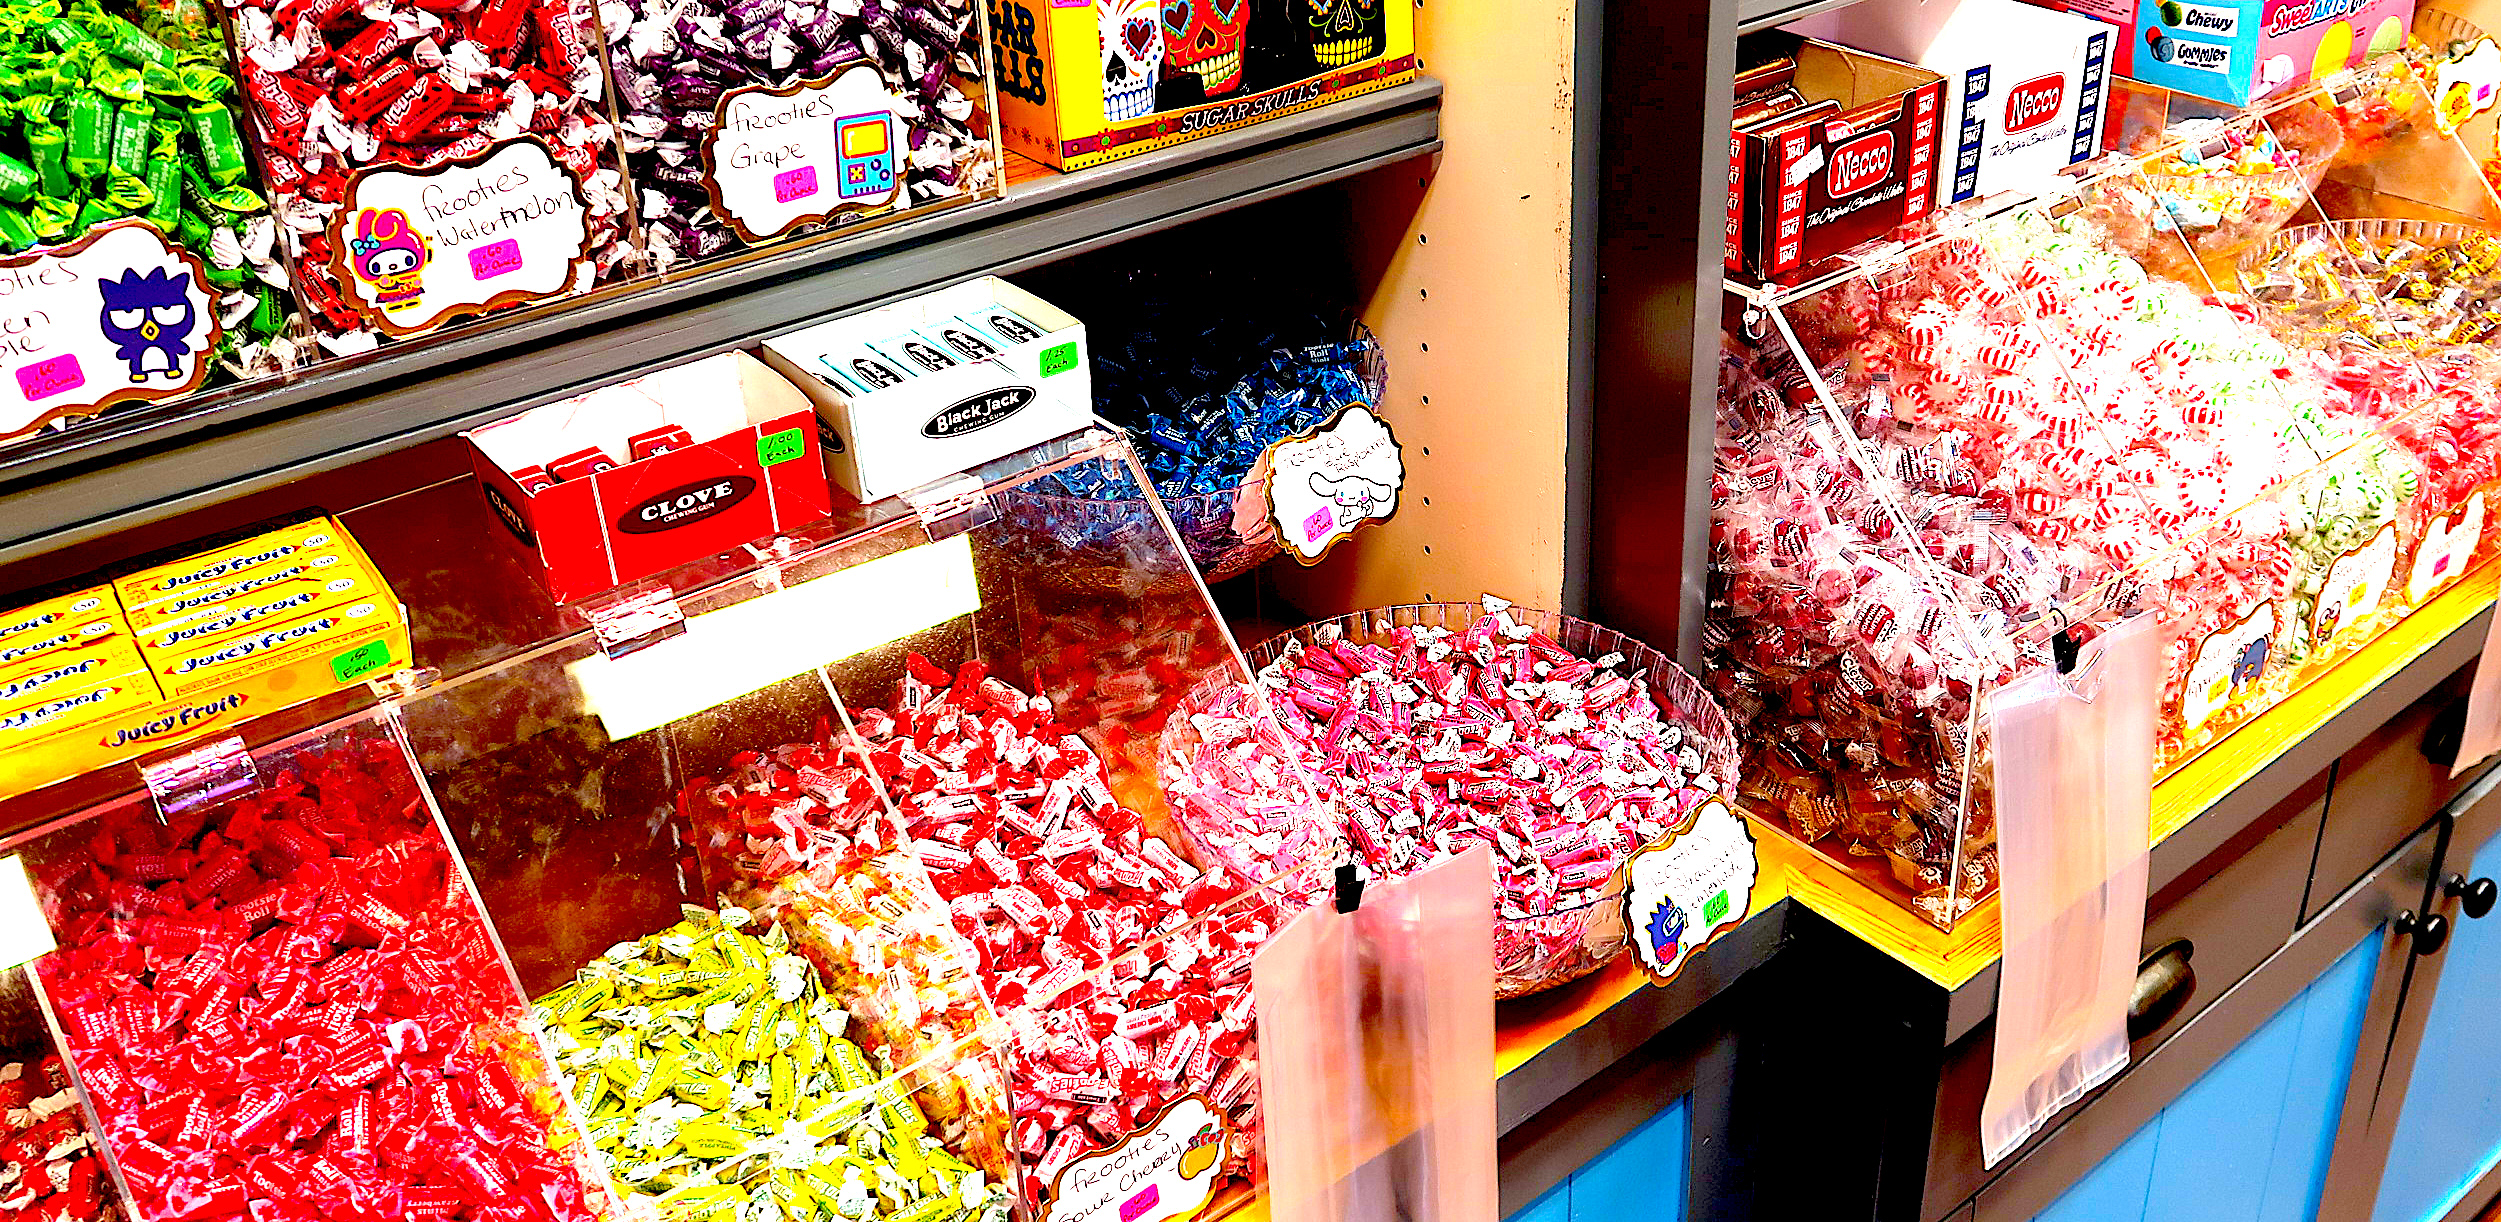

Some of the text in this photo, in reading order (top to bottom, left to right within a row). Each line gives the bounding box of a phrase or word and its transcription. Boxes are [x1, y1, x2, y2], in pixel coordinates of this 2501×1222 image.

[2185, 8, 2234, 31] Chewy
[1181, 79, 1322, 134] SUGAR SKULLS
[1917, 98, 1934, 115] 1847
[2009, 87, 2060, 128] Necco
[1916, 124, 1932, 140] 1847
[731, 143, 806, 168] Grape
[1785, 142, 1805, 160] 1847
[1913, 150, 1929, 166] 1847
[1835, 145, 1888, 192] Necco
[1911, 175, 1927, 191] 1847
[1782, 195, 1801, 213] 1847
[1907, 199, 1924, 216] 1847
[1780, 222, 1799, 238] 1847
[1778, 247, 1797, 264] 1847
[1309, 349, 1329, 360] Roll
[935, 391, 1020, 433] Black Jack
[641, 481, 734, 521] CLOVE
[663, 501, 716, 523] CHEWING GUM
[160, 545, 295, 590] Juicy Fruit
[168, 566, 304, 613] Juicy Fruit
[160, 592, 313, 648] Juicy Fruit
[176, 619, 333, 673] Juicy Fruit
[342, 658, 377, 680] Each
[111, 715, 176, 748] Juicy
[179, 693, 241, 726] Fruit
[243, 905, 270, 922] Roll
[206, 1022, 228, 1038] Roll
[331, 1060, 385, 1087] Tootsie
[1051, 1076, 1110, 1094] Frooties
[436, 1082, 455, 1123] Tootsie
[178, 1089, 205, 1142] Tootsie
[192, 1106, 209, 1137] Roll
[340, 1109, 352, 1138] Roll
[313, 1159, 340, 1181] Roll
